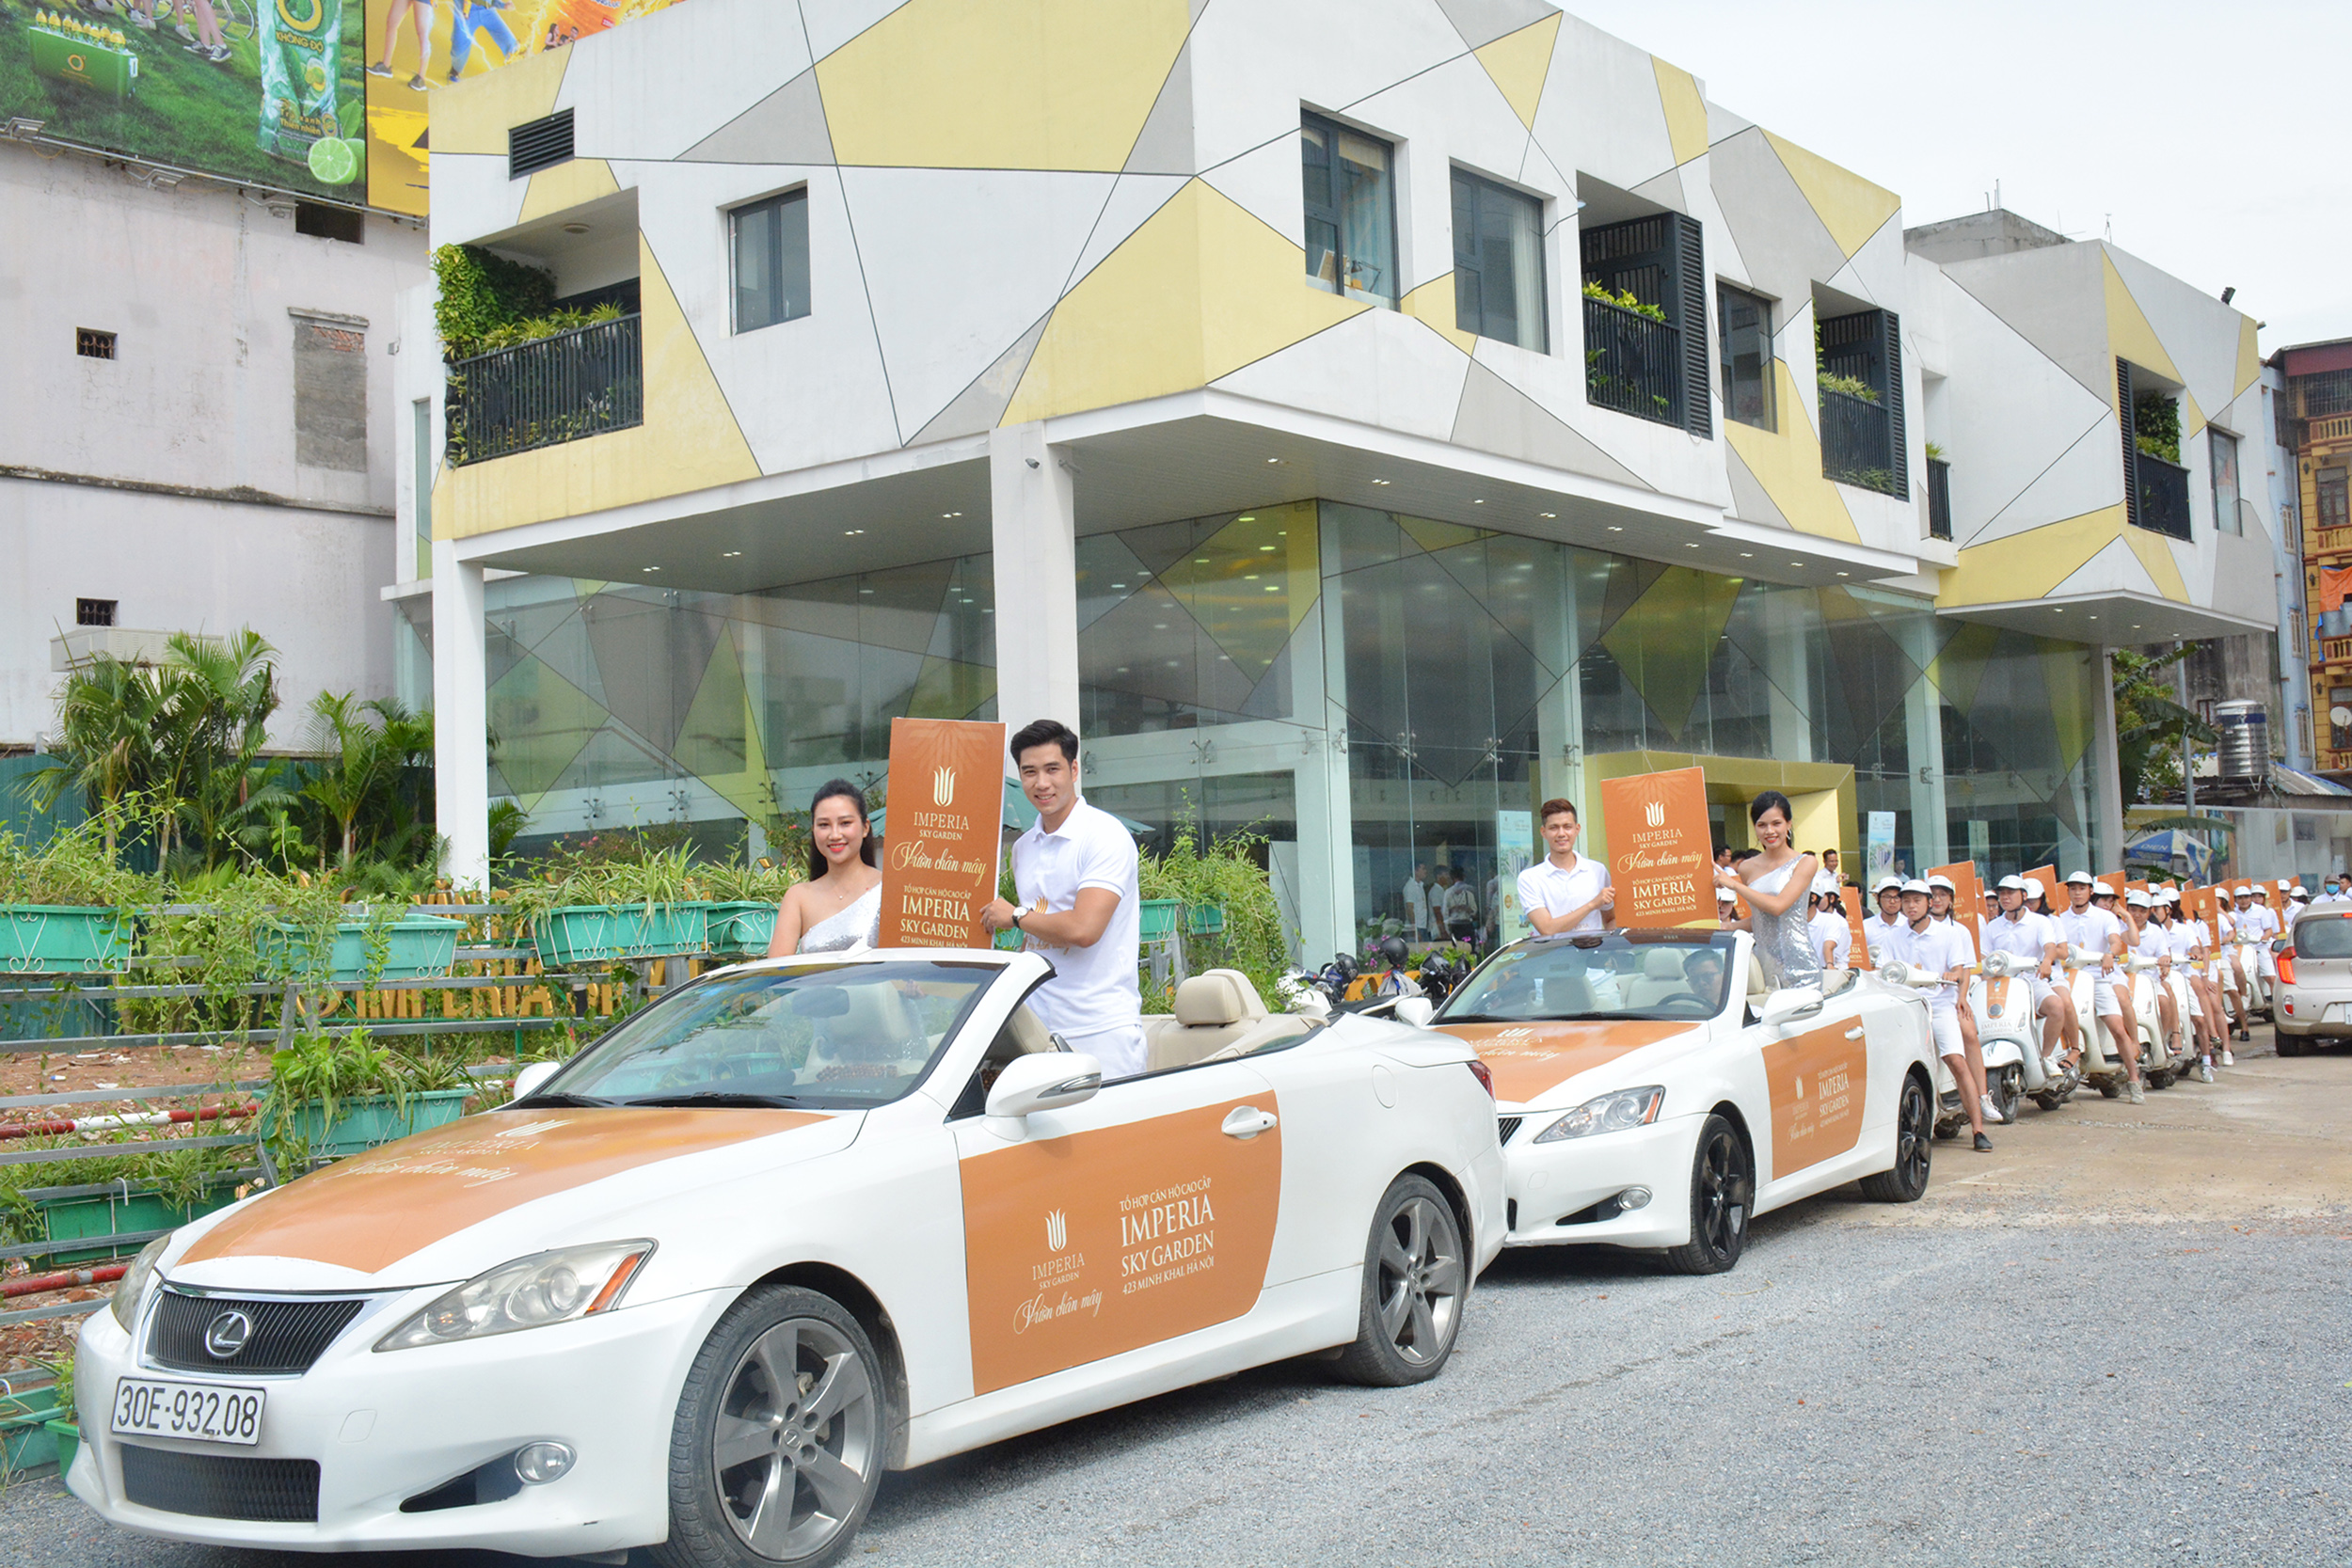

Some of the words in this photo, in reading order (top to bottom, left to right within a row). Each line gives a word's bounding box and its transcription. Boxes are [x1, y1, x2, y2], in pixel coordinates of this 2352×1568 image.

[276, 30, 309, 47] KHÔNG
[914, 812, 969, 830] IMPERIA
[919, 830, 931, 838] SKY
[932, 831, 962, 840] GARDEN
[1632, 829, 1683, 843] IMPERIA
[1651, 839, 1677, 847] GARDEN
[934, 847, 960, 872] chân
[961, 858, 987, 887] mây
[1632, 879, 1695, 898] IMPERIA
[902, 895, 971, 922] IMPERIA
[1633, 900, 1651, 911] SKY
[1653, 895, 1695, 908] GARDEN
[900, 918, 920, 933] SKY
[921, 921, 969, 940] GARDEN
[1819, 1072, 1850, 1100] IMPERIA
[1120, 1195, 1132, 1212] TỔ
[1132, 1194, 1149, 1209] HỢP
[1168, 1183, 1181, 1199] HỘ
[1181, 1180, 1197, 1195] CAO
[1120, 1193, 1216, 1248] IMPERIA
[1121, 1248, 1150, 1277] SKY
[1152, 1230, 1215, 1267] GARDEN
[1032, 1252, 1085, 1280] IMPERIA
[1122, 1281, 1136, 1294] 423
[1137, 1273, 1163, 1291] MINH
[1186, 1259, 1199, 1275] HÀ
[1200, 1255, 1215, 1270] NỘI
[1039, 1280, 1052, 1291] SKY
[1052, 1271, 1080, 1286] GARDEN
[1056, 1291, 1078, 1317] chân
[1081, 1289, 1103, 1318] mây
